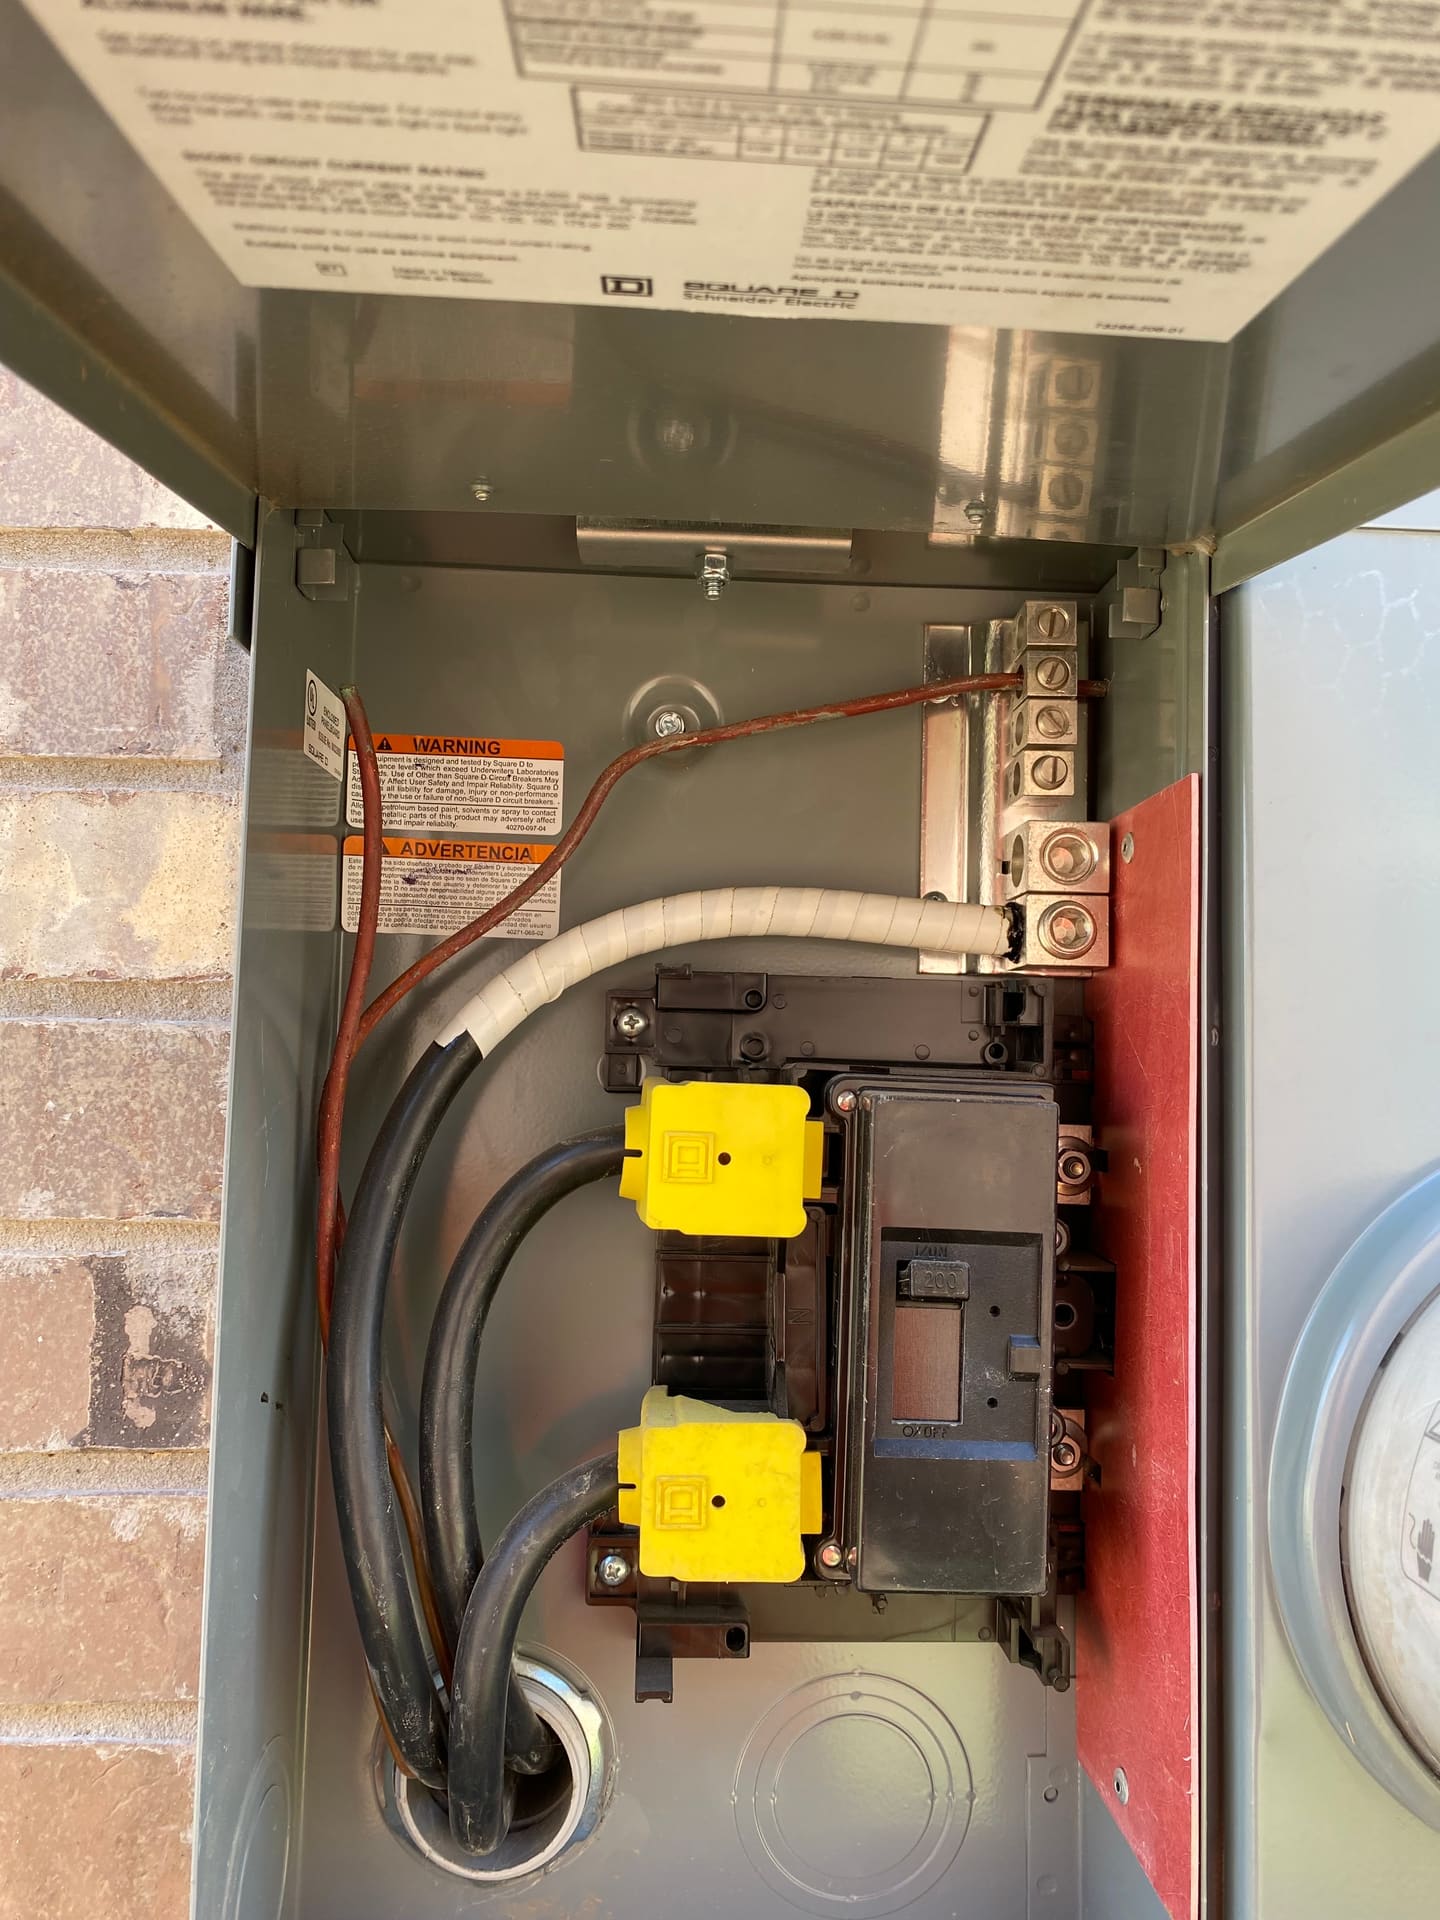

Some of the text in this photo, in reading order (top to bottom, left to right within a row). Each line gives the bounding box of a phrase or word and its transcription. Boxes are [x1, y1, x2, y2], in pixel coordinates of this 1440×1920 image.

[683, 281, 860, 299] SQUARE D
[683, 292, 857, 310] Schneider Electric
[413, 738, 501, 755] WARNING
[517, 768, 558, 776] Laboratories
[428, 779, 449, 787] Safety
[490, 782, 524, 790] Reliability.
[527, 783, 550, 791] Square
[436, 787, 465, 796] damage,
[454, 795, 493, 803] non-Square
[382, 804, 415, 812] petroleum
[441, 806, 460, 814] paint,
[454, 814, 480, 822] product
[427, 820, 458, 828] reliability.
[400, 842, 532, 860] ADVERTENCIA
[924, 1270, 958, 1291] 200
